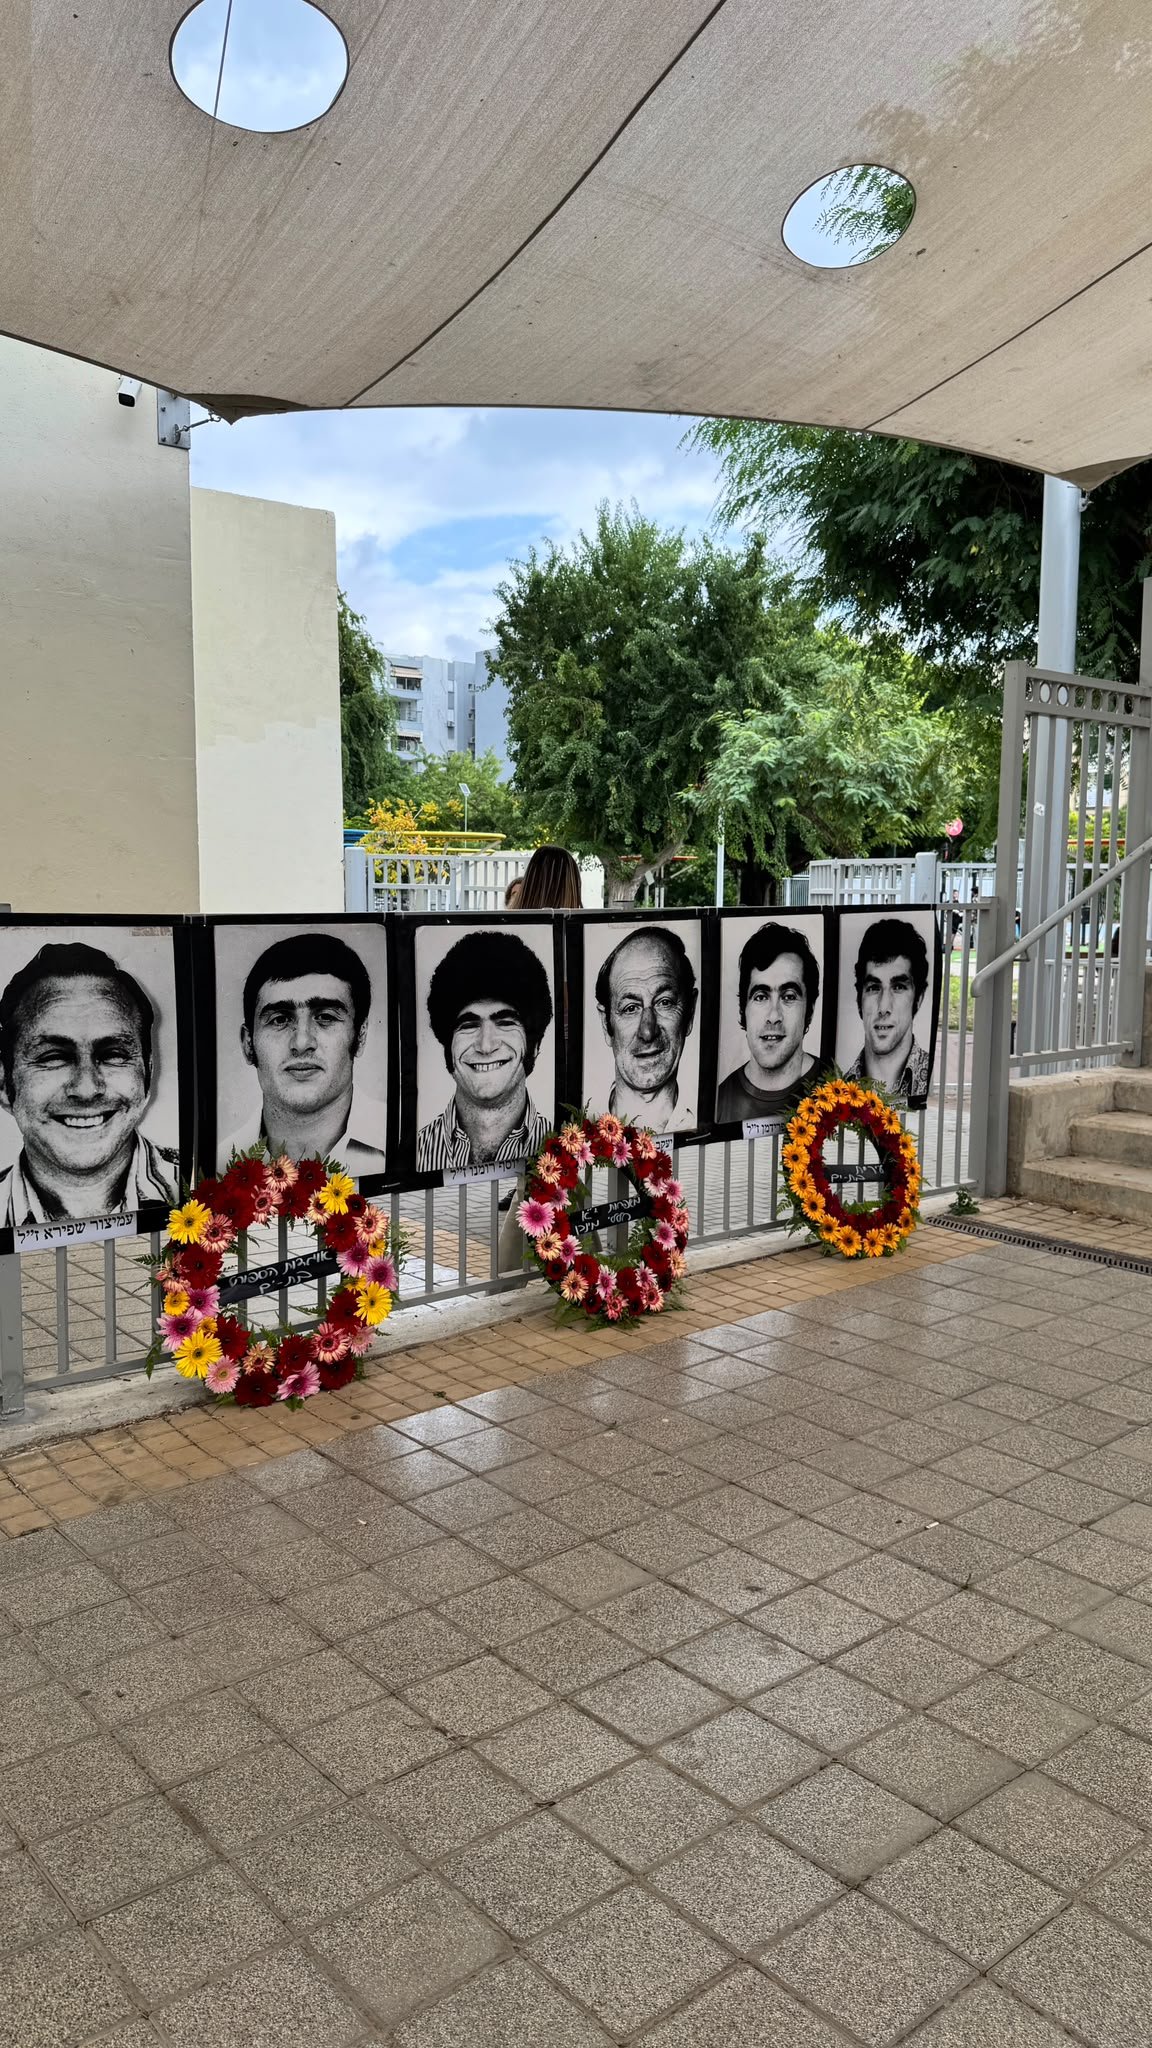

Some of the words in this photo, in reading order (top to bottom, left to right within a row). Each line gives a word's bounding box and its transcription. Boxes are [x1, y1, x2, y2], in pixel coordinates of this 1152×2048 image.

[469, 1162, 496, 1176] רומנו
[498, 1159, 519, 1172] וסף
[44, 1221, 86, 1240] שפירא
[90, 1213, 134, 1231] עמיצור
[229, 1267, 279, 1287] הספורט
